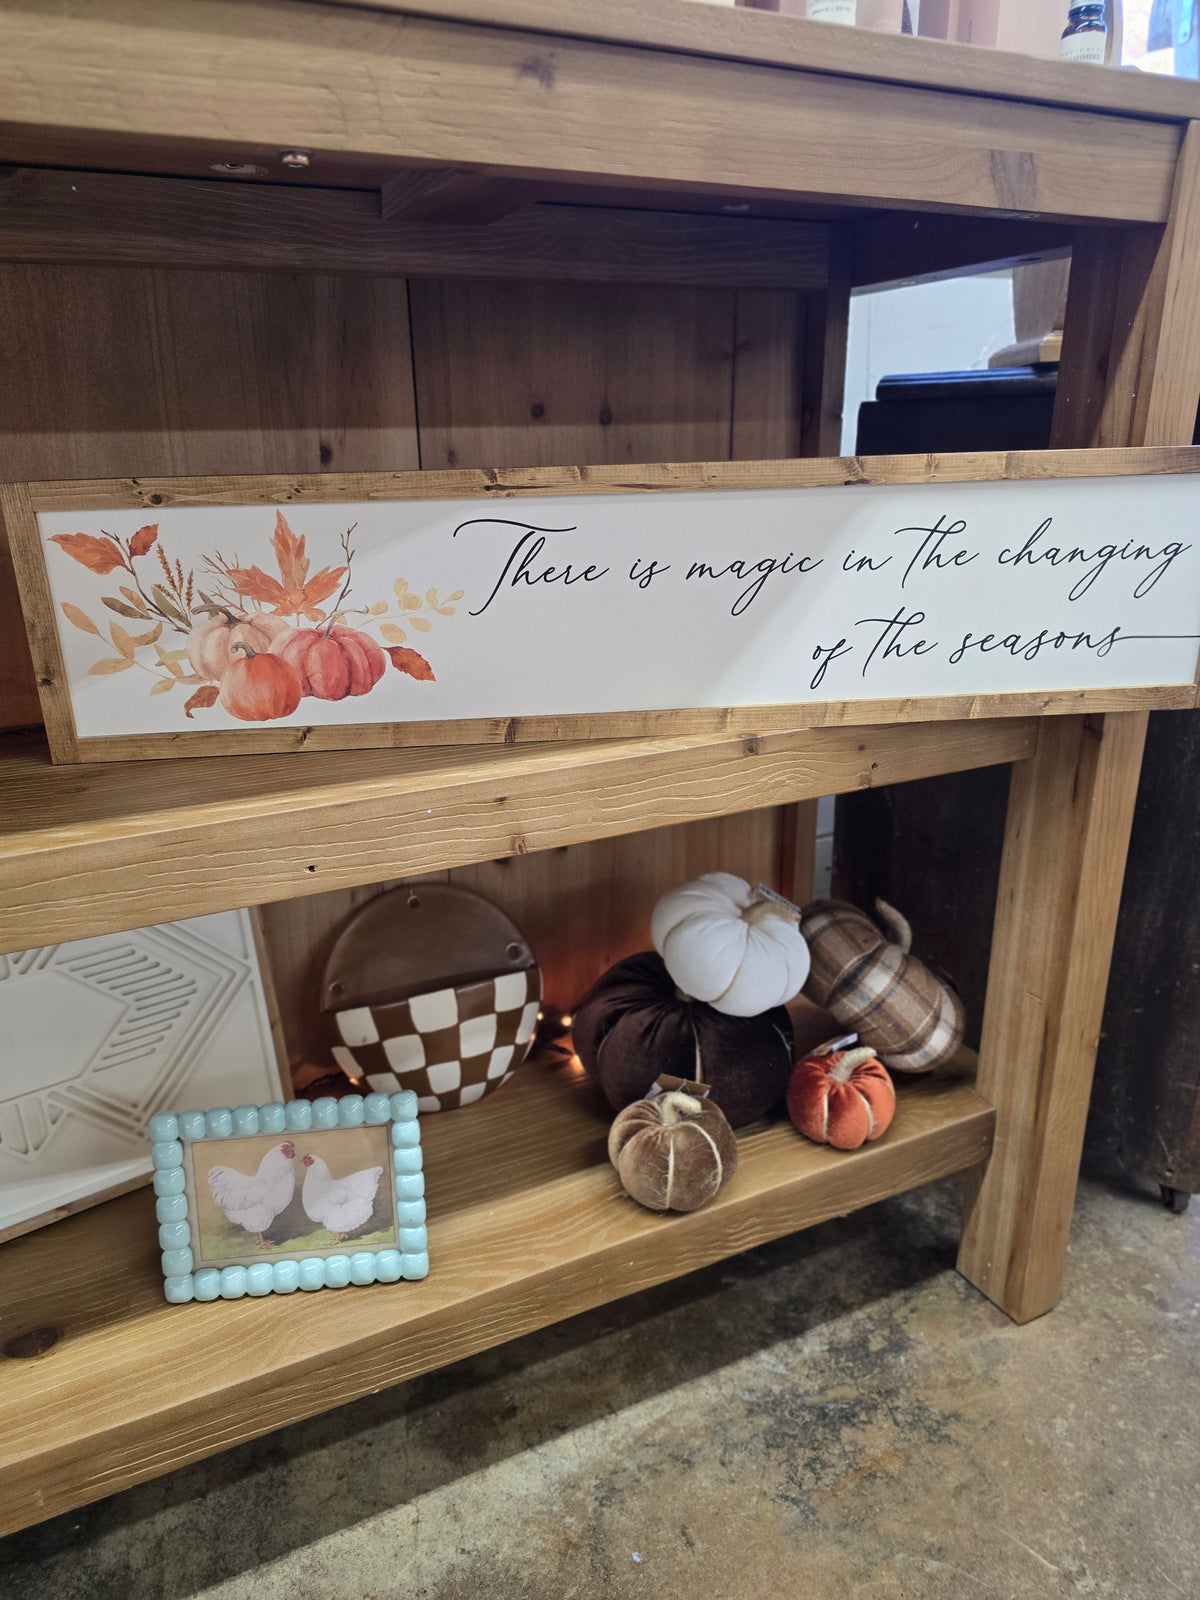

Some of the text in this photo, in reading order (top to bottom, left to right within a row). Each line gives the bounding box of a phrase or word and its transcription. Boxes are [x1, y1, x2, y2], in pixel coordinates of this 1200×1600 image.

[453, 518, 610, 616] There
[629, 558, 671, 589] is
[685, 552, 824, 616] magic
[842, 549, 893, 572] in
[997, 517, 1193, 602] changing
[810, 637, 853, 690] of
[949, 626, 1200, 665] seasons
